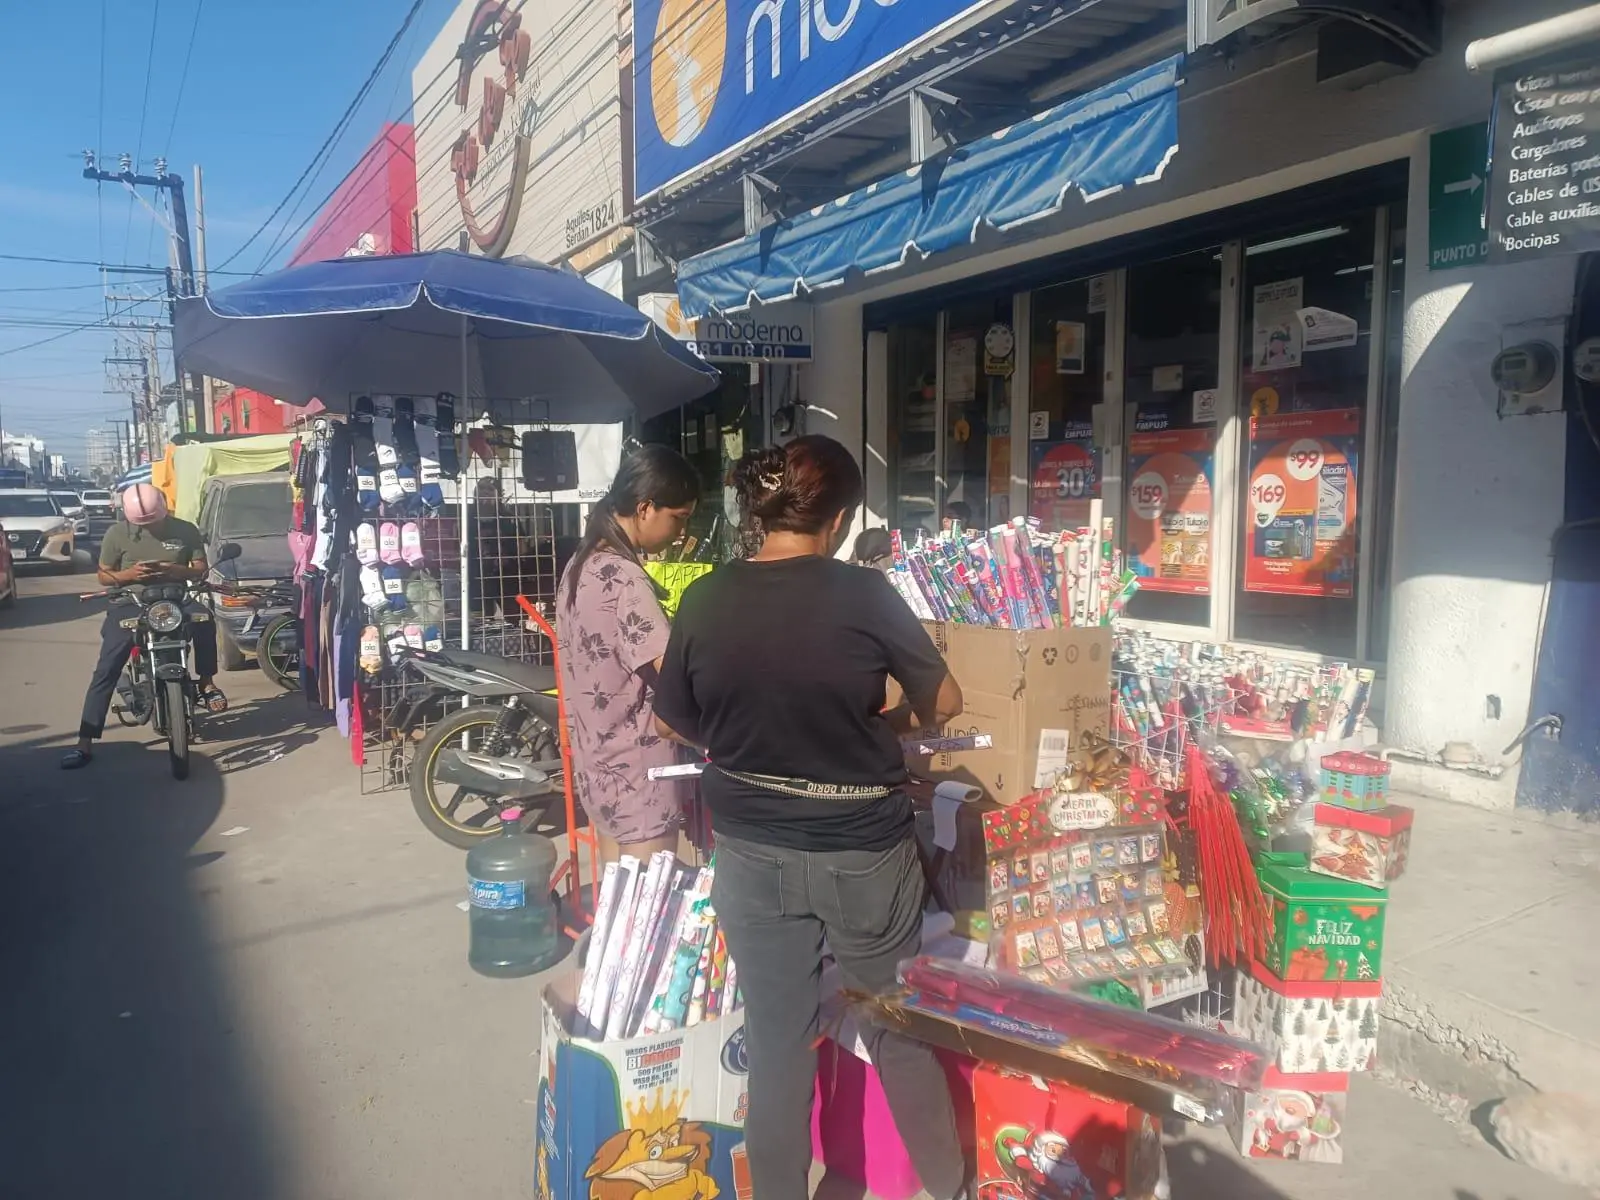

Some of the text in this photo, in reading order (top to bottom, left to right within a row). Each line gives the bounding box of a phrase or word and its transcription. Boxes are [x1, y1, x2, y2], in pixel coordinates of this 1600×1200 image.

[1511, 135, 1588, 161] Cargadores
[1509, 162, 1568, 184] Baterías
[1507, 188, 1554, 206] Cables
[1559, 183, 1579, 199] de
[565, 207, 591, 233] Aquiles
[590, 200, 615, 234] 1824
[1507, 202, 1600, 228] Cable auxilia
[1505, 232, 1560, 251] Bocinas
[1433, 243, 1490, 263] PUNTO D
[707, 319, 802, 342] moderna
[1290, 450, 1320, 469] $99
[1132, 484, 1163, 504] $159
[1252, 484, 1286, 504] $169
[1061, 797, 1099, 810] MERRY
[1054, 809, 1110, 823] CHRISTMAS
[1315, 918, 1354, 935] FELIZ
[1308, 934, 1361, 946] NAVIDAD
[625, 1038, 684, 1056] VASOS PLASTICOS
